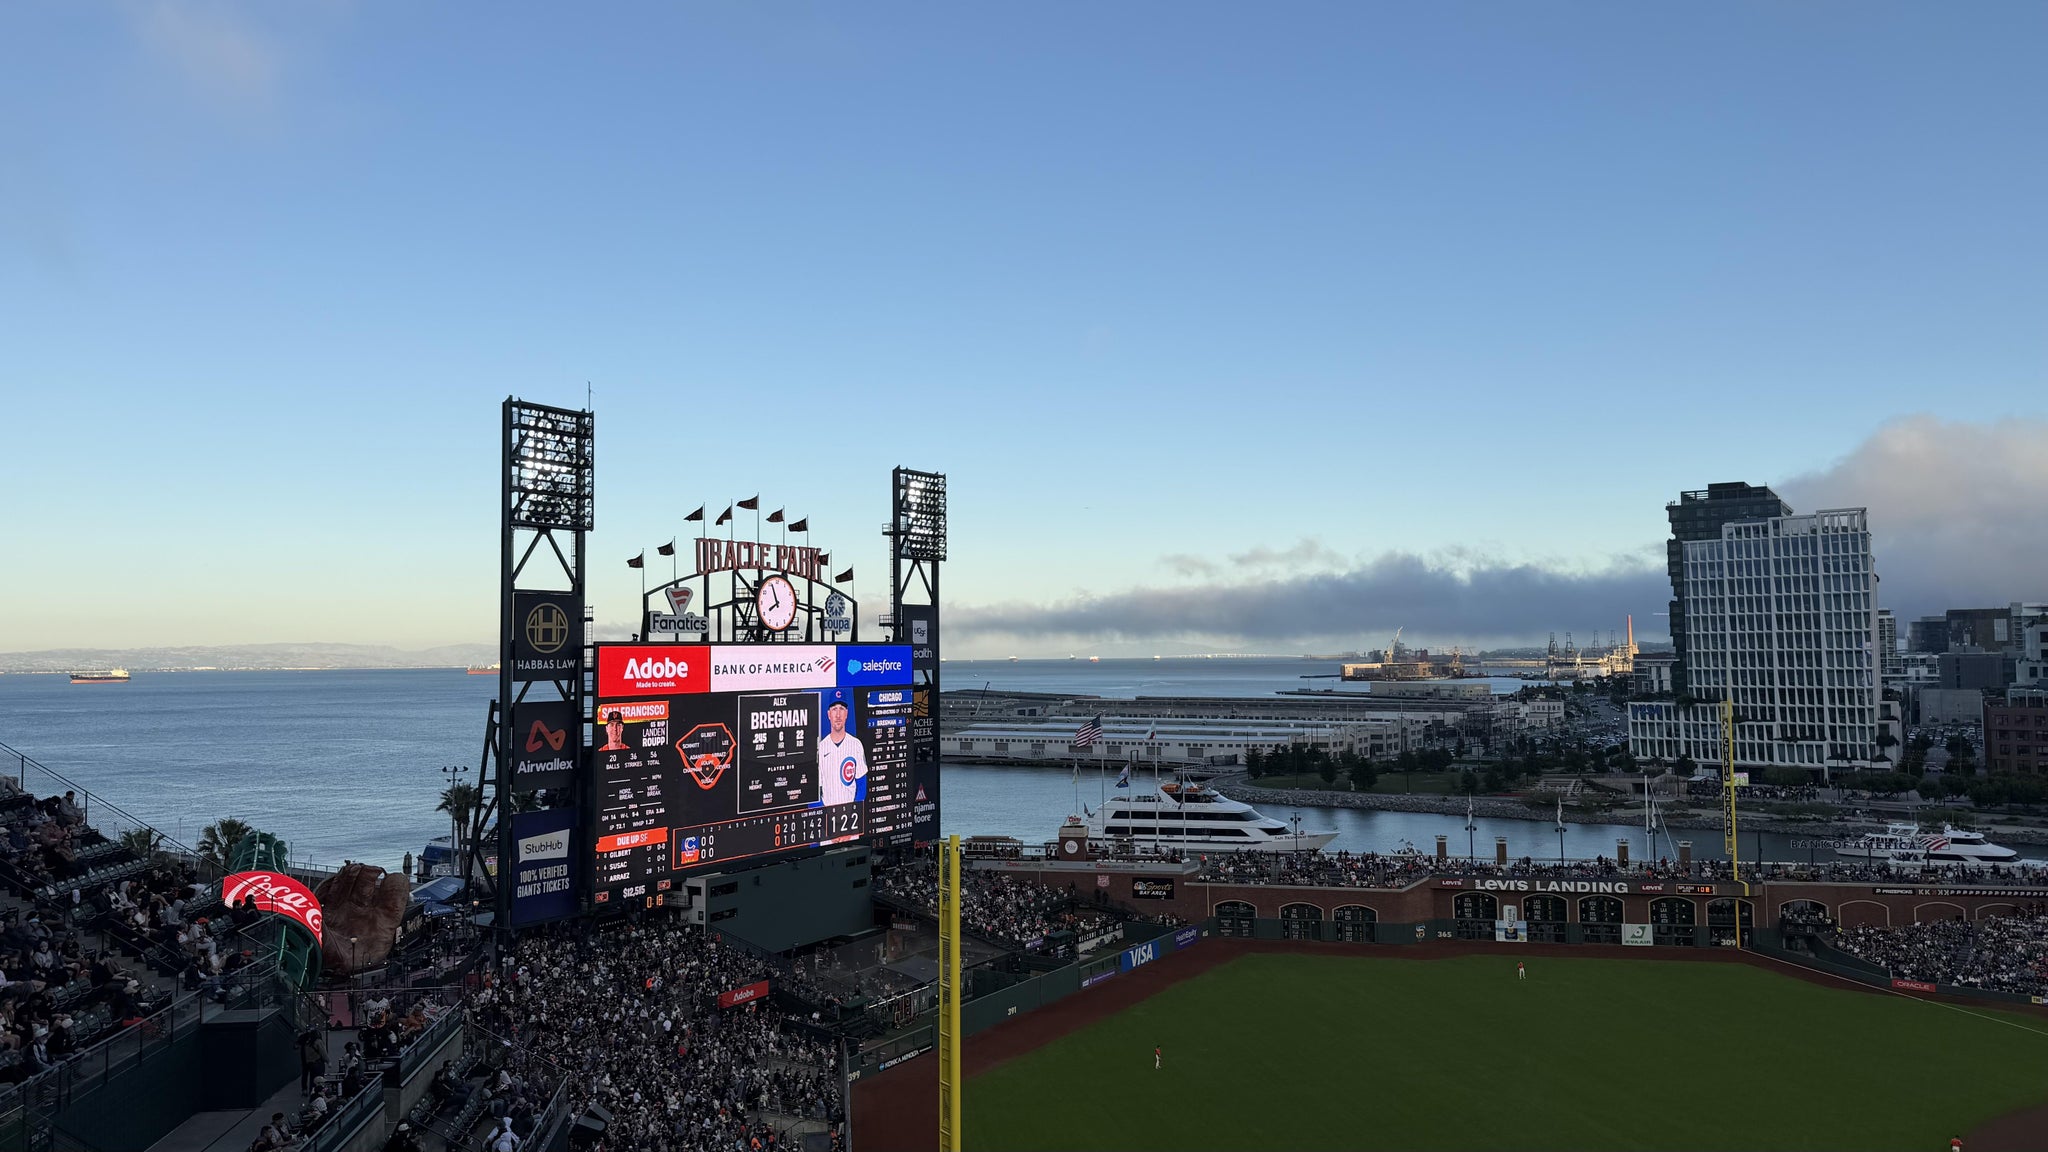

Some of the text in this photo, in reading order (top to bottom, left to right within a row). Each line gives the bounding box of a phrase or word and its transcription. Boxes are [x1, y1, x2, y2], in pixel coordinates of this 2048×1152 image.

[696, 538, 822, 582] ORACLE PARK
[652, 614, 708, 630] Fanatics
[824, 618, 850, 632] coupa
[518, 659, 576, 670] HABBAS LAW
[624, 657, 688, 679] Adobe
[714, 663, 813, 675] BANK OF AMERICA
[863, 659, 902, 673] salesforce
[773, 698, 787, 706] ALEX
[879, 692, 902, 702] CHICAGO
[621, 705, 665, 717] FRANCISCO
[751, 709, 808, 730] BREGMAN
[914, 718, 933, 727] ACHE
[643, 728, 665, 737] LANDEN
[753, 733, 767, 743] .245
[796, 730, 804, 739] 22
[914, 728, 932, 736] REEK
[643, 737, 665, 747] ROUPP
[517, 758, 573, 774] Airwallex
[832, 813, 858, 833] 1 2 2
[701, 837, 706, 846] 0
[709, 835, 714, 845] 0
[775, 824, 780, 835] 0
[784, 823, 788, 833] 2
[791, 822, 796, 831] 0
[810, 819, 814, 828] 4
[818, 818, 821, 827] 2
[617, 833, 648, 846] DUE UP SF
[701, 849, 706, 859] 0
[709, 848, 714, 857] 0
[775, 836, 780, 847] 0
[791, 834, 796, 843] 0
[810, 831, 814, 839] 4
[1791, 840, 1917, 849] BANK OF AMERICA
[525, 840, 562, 854] StubHub
[610, 849, 631, 858] GILBERT
[610, 862, 627, 870] SUSAC
[520, 864, 568, 883] 100% VERIFIED
[609, 873, 630, 882] ARRAEZ
[517, 878, 570, 898] GIANTS TICKETS
[1146, 882, 1173, 892] Sports
[1536, 880, 1629, 893] LANDING
[1129, 944, 1153, 967] VISA
[1897, 981, 1929, 990] ORACLE
[733, 989, 754, 1001] Adobe
[1008, 1006, 1017, 1016] 391
[885, 1050, 919, 1070] KONICA MINOLTA
